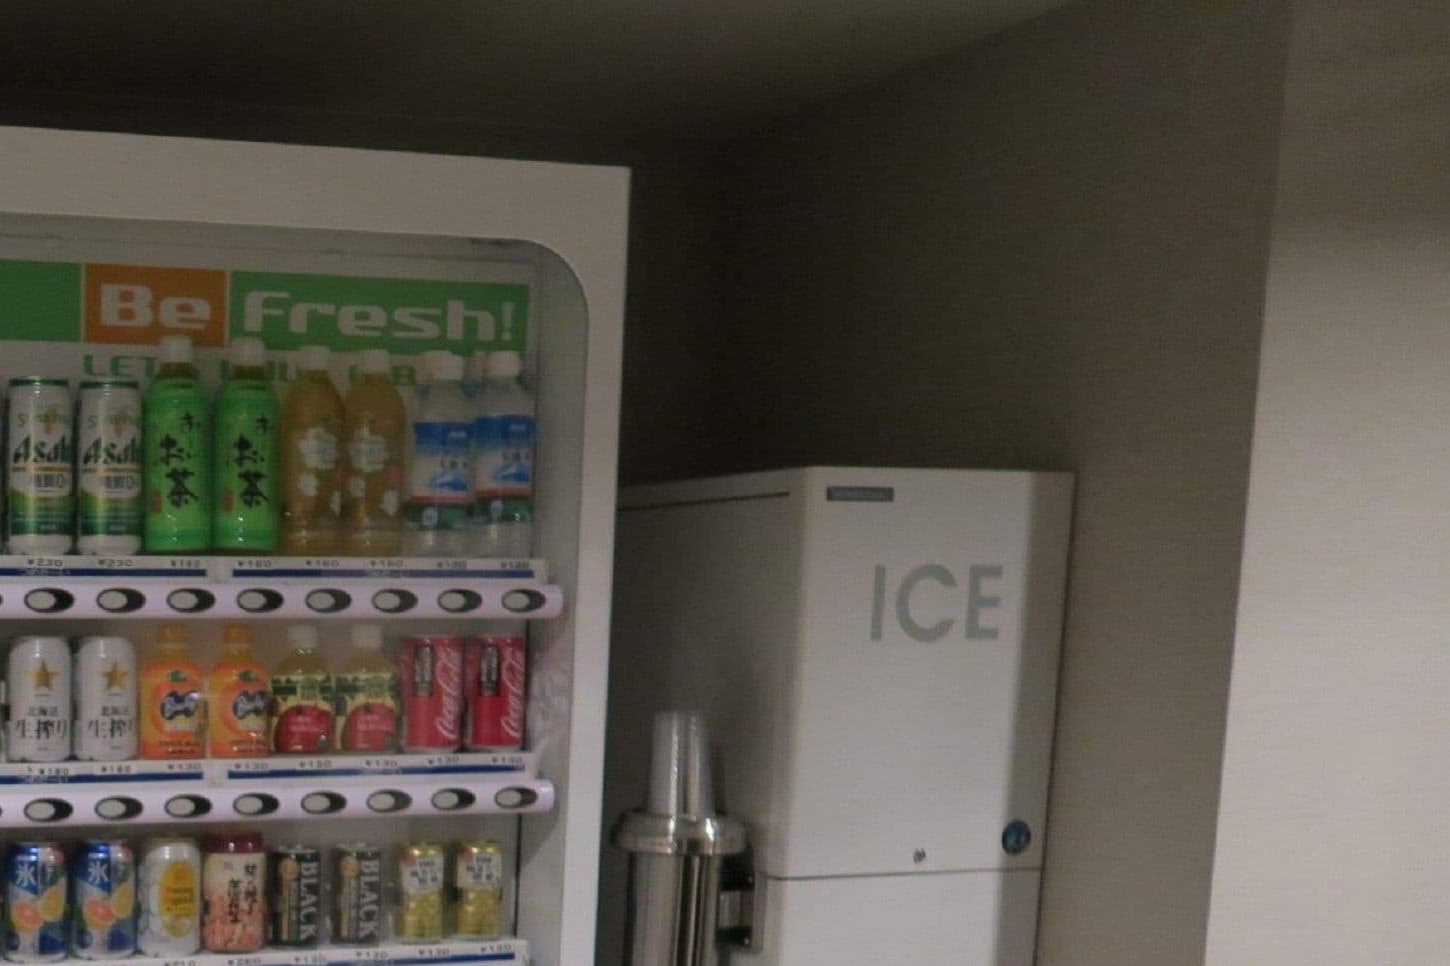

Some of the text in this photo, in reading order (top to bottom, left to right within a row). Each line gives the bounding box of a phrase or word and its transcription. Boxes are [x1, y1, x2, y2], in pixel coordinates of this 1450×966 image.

[100, 283, 211, 330] Be
[243, 291, 515, 341] Fresh!
[871, 564, 1003, 642] ICE
[358, 859, 380, 939] BLACK
